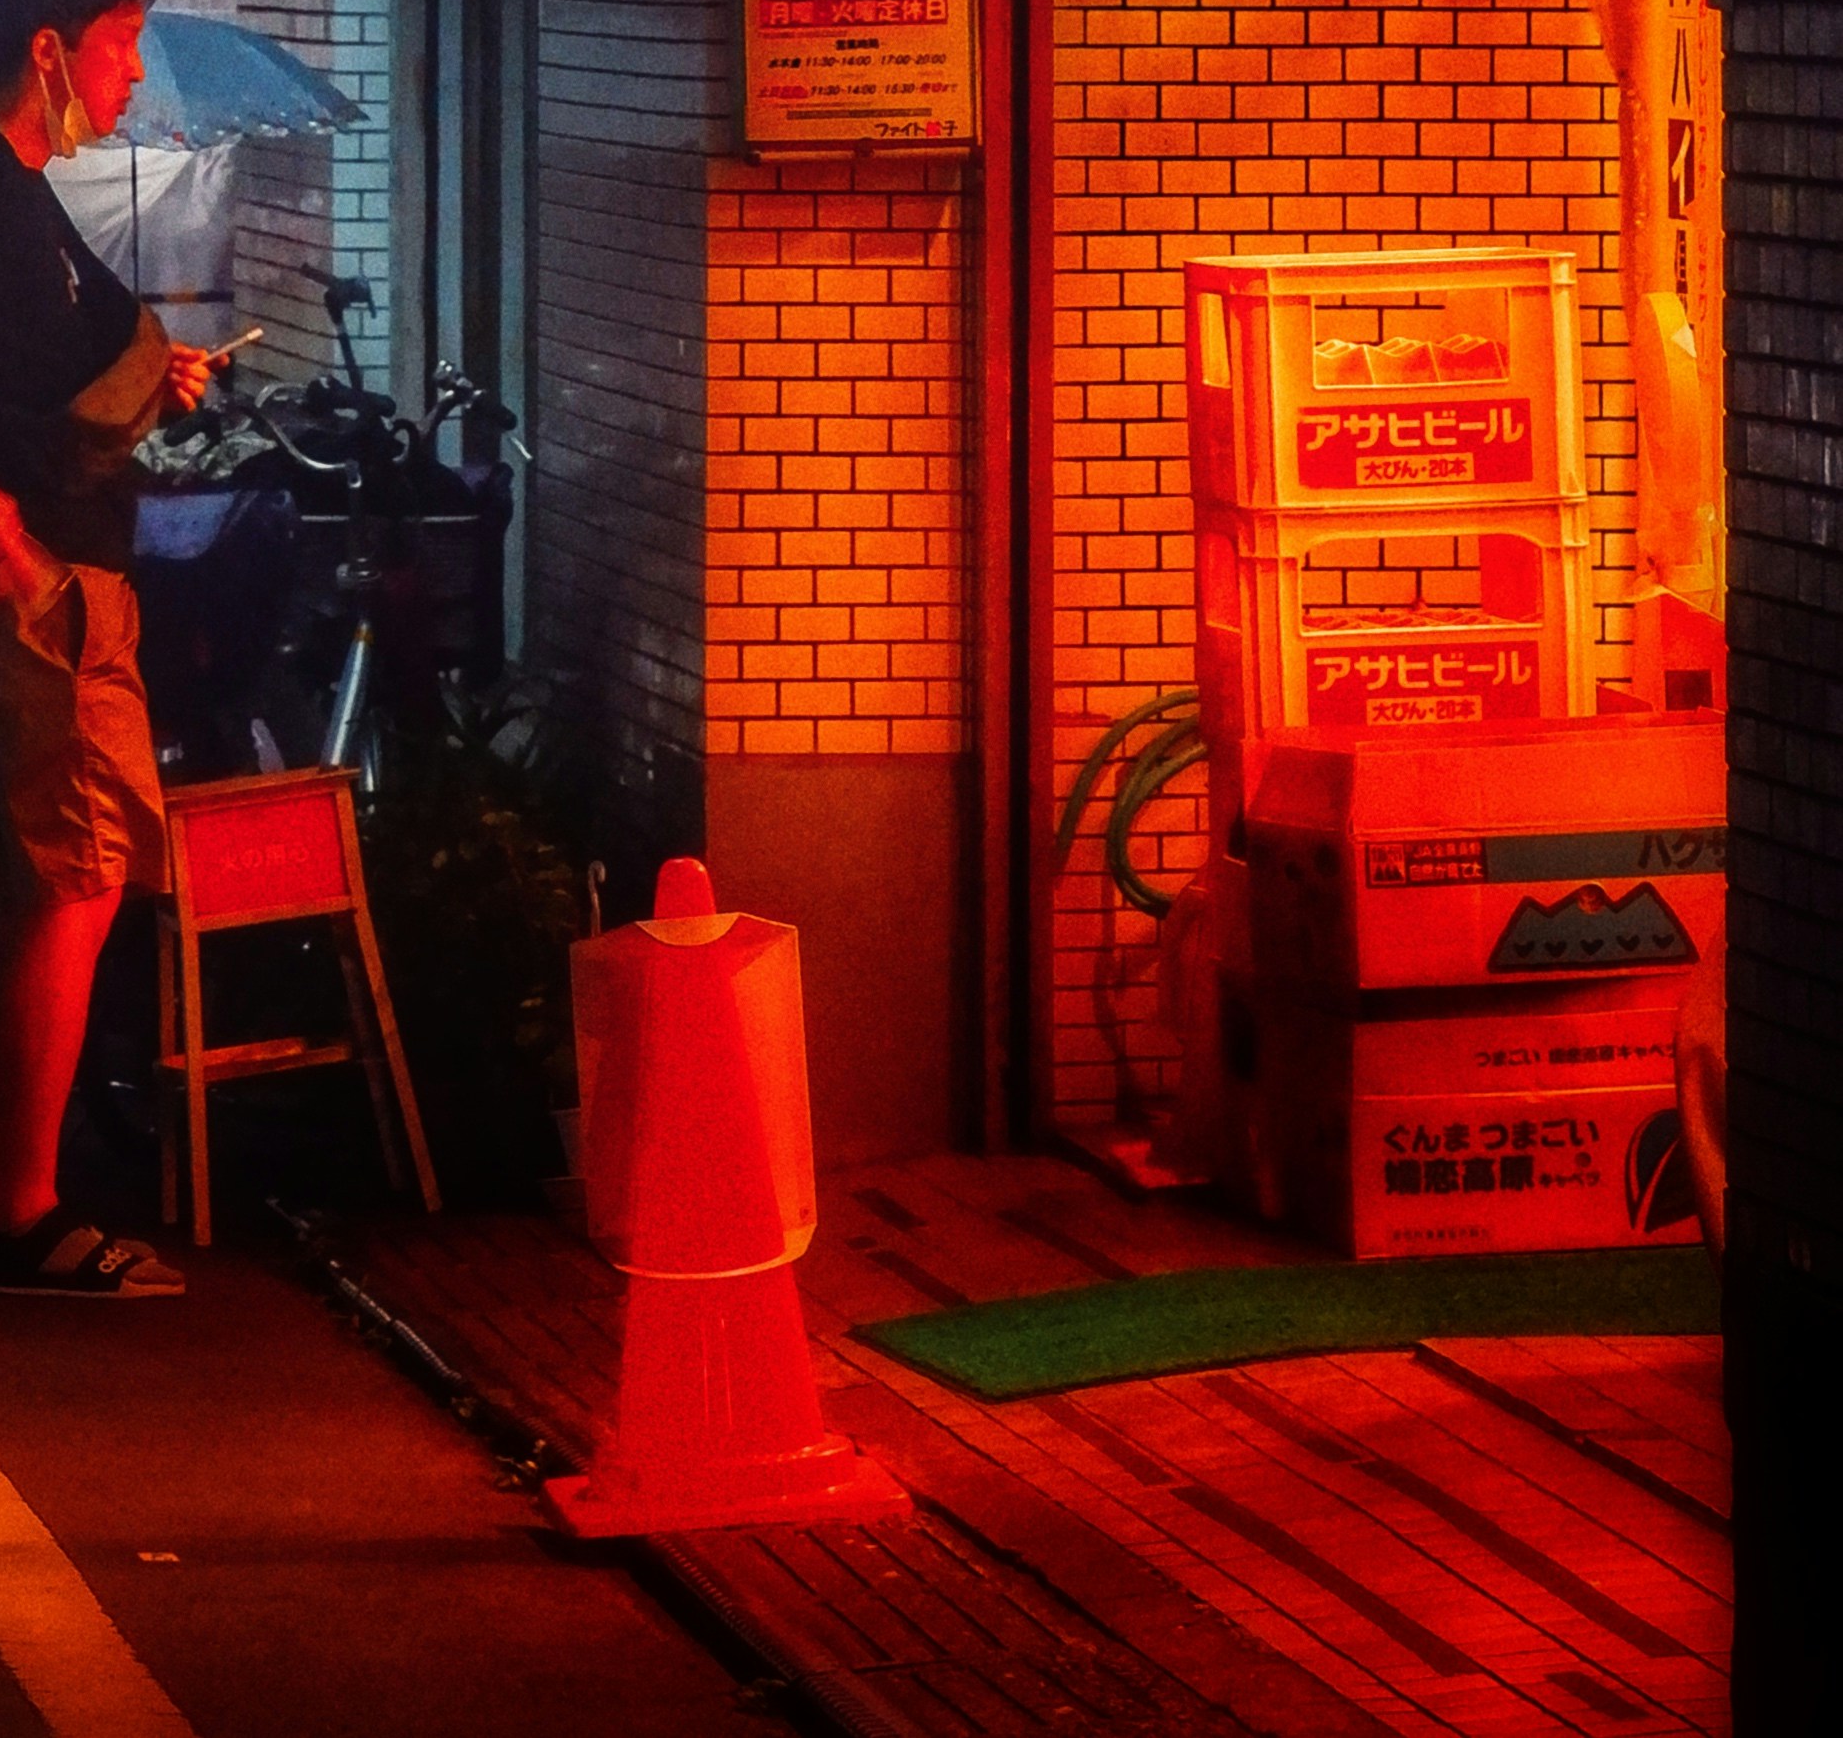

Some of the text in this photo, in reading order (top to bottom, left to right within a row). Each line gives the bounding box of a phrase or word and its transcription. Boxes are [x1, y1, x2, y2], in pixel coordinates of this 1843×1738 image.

[1302, 407, 1524, 450] アサヒビール
[1363, 458, 1467, 480] 大びん・20本
[1314, 650, 1532, 691] アサヒビール
[1372, 698, 1476, 722] 大びん・20本
[1479, 1118, 1601, 1151] つまごい
